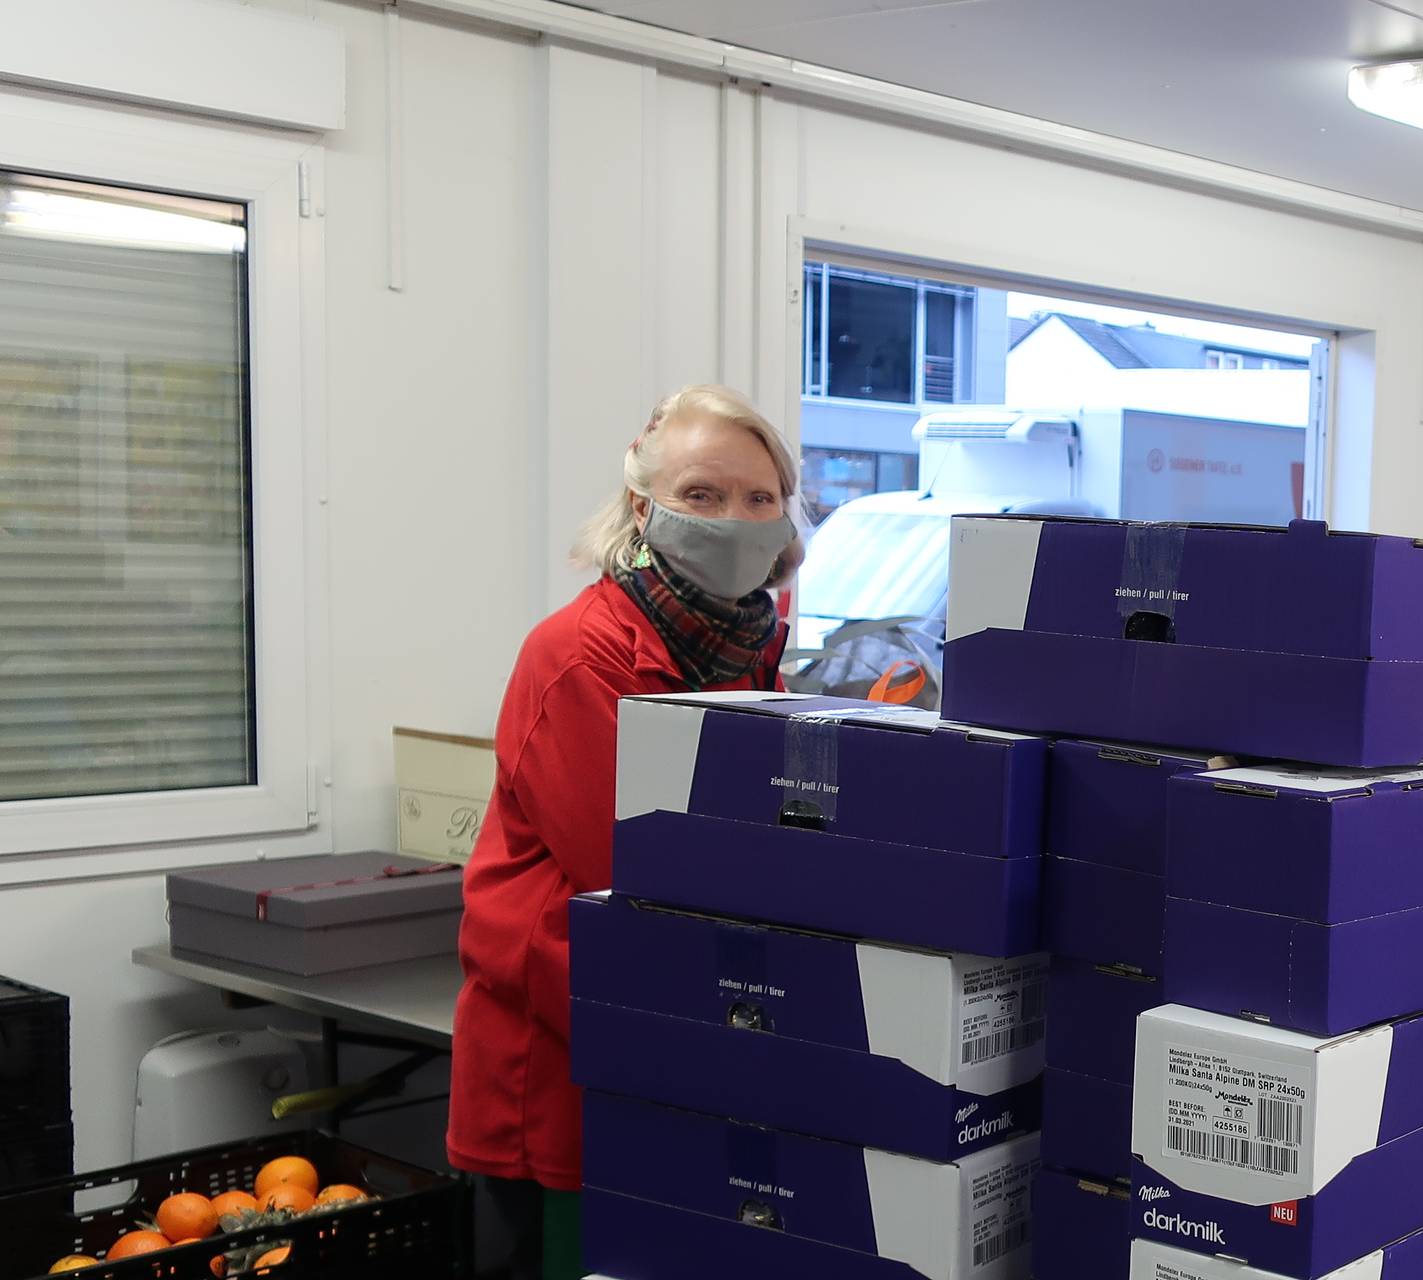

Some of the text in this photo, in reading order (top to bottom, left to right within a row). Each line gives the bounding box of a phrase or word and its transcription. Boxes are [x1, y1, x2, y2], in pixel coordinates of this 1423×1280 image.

[1115, 586, 1141, 598] ziehen
[1149, 589, 1165, 600] pull
[1172, 590, 1189, 601] tirer
[770, 776, 795, 788] ziehen
[801, 781, 816, 791] pull
[823, 783, 840, 794] tirer
[718, 978, 742, 990] ziehen
[748, 984, 763, 993] pull
[769, 986, 785, 997] tirer
[1168, 1063, 1306, 1099] Milka Santa Alpine DM SRP 24x50g
[954, 1101, 979, 1124] Milka
[1168, 1099, 1182, 1108] BEST
[957, 1109, 1015, 1145] darkmilk
[1214, 1120, 1248, 1135] 4255186
[728, 1177, 752, 1189] ziehen
[758, 1184, 772, 1193] pull
[778, 1186, 794, 1199] tirer
[1138, 1184, 1171, 1202] Milka
[1143, 1206, 1294, 1245] darkmilk NEU
